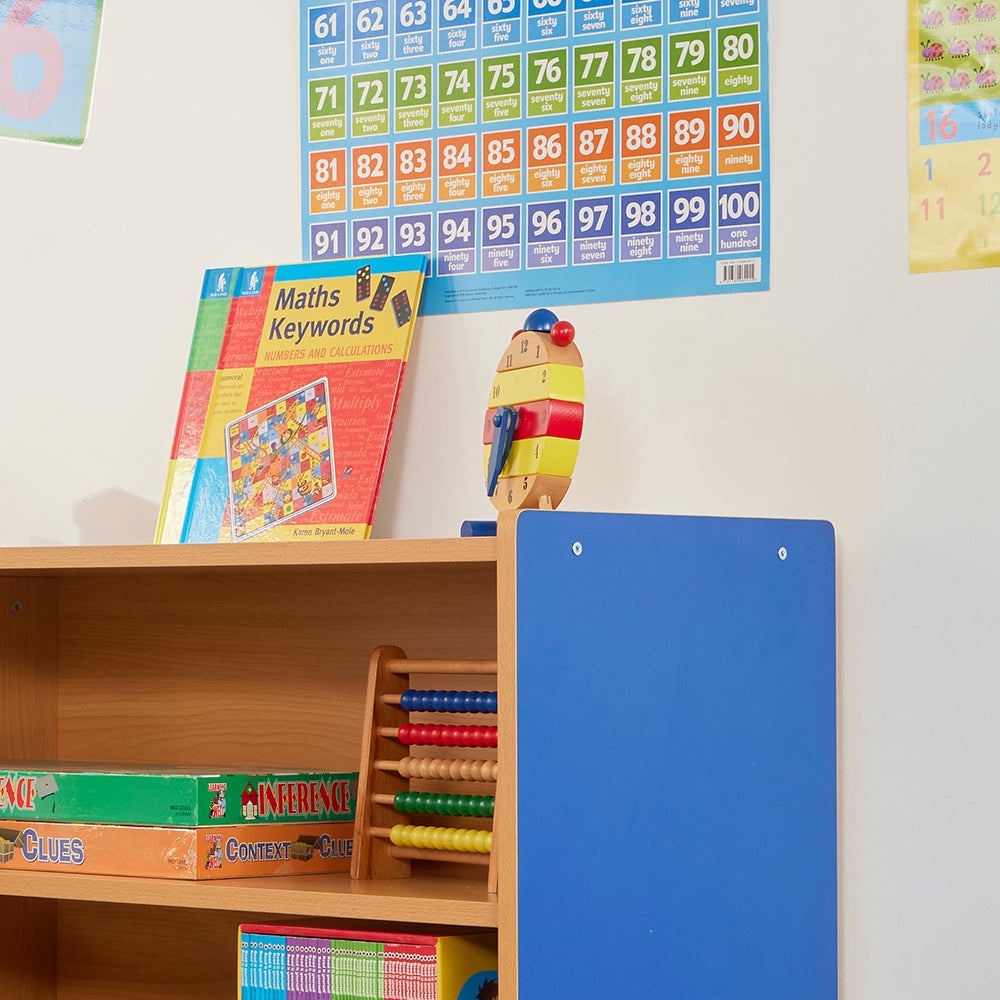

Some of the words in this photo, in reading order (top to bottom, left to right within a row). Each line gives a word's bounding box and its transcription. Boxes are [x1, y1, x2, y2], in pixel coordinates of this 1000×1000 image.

[631, 5, 652, 15] sixty
[679, 0, 700, 8] sixty
[400, 0, 426, 27] 63
[443, 0, 472, 21] 64
[583, 10, 605, 21] sixty
[680, 8, 699, 18] nine
[357, 7, 384, 33] 62
[537, 17, 557, 27] sixty
[582, 20, 606, 30] seven
[630, 13, 653, 25] eight
[315, 13, 337, 38] 61
[491, 23, 511, 33] sixty
[541, 27, 553, 36] six
[404, 35, 424, 45] sixty
[447, 29, 467, 39] sixty
[493, 32, 509, 42] five
[318, 46, 337, 56] sixty
[361, 41, 380, 51] sixty
[723, 33, 754, 61] 80
[675, 39, 705, 67] 79
[580, 51, 609, 79] 77
[627, 46, 656, 73] 78
[488, 63, 515, 90] 75
[534, 57, 561, 84] 76
[444, 69, 471, 95] 74
[625, 80, 658, 92] seventy
[672, 75, 707, 86] seventy
[724, 75, 753, 87] eighty
[357, 80, 384, 106] 72
[400, 74, 427, 101] 73
[577, 86, 610, 98] seventy
[680, 87, 699, 96] nine
[315, 85, 337, 111] 71
[531, 92, 564, 103] seventy
[581, 97, 606, 107] seven
[630, 91, 652, 103] eight
[441, 102, 473, 114] seventy
[486, 98, 517, 109] seventy
[541, 103, 553, 111] six
[355, 113, 386, 124] seventy
[398, 108, 429, 119] seventy
[493, 108, 509, 117] five
[312, 118, 343, 129] seventy
[722, 112, 754, 141] 90
[925, 108, 958, 141] 16
[626, 123, 656, 150] 88
[674, 118, 705, 145] 89
[533, 133, 561, 160] 86
[579, 128, 608, 155] 87
[443, 143, 472, 169] 84
[487, 139, 515, 165] 85
[400, 148, 426, 174] 83
[628, 157, 655, 170] eighty
[675, 153, 703, 165] eighty
[725, 153, 753, 165] ninety
[315, 158, 337, 183] 81
[357, 153, 384, 178] 82
[580, 164, 608, 175] eighty
[681, 164, 700, 174] nine
[924, 158, 933, 181] 1
[978, 153, 992, 176] 2
[489, 173, 515, 184] eighty
[534, 168, 561, 179] eighty
[581, 174, 606, 183] seven
[629, 168, 651, 180] eight
[401, 182, 426, 193] eighty
[444, 177, 470, 189] eighty
[493, 183, 508, 193] five
[541, 178, 553, 187] six
[316, 191, 341, 201] eighty
[358, 187, 382, 197] eighty
[674, 196, 705, 224] 99
[719, 191, 759, 219] 100
[921, 197, 945, 221] 11
[578, 205, 608, 232] 97
[626, 201, 656, 228] 98
[487, 213, 515, 240] 95
[532, 209, 562, 236] 96
[400, 222, 426, 248] 93
[442, 217, 471, 244] 94
[730, 229, 748, 238] one
[315, 230, 338, 255] 91
[357, 226, 384, 252] 92
[627, 236, 655, 247] ninety
[675, 231, 703, 243] ninety
[720, 237, 758, 249] hundred
[534, 244, 560, 255] ninety
[580, 240, 606, 251] ninety
[680, 242, 699, 252] nine
[444, 252, 469, 263] ninety
[488, 248, 514, 258] ninety
[581, 250, 606, 260] seven
[629, 246, 652, 258] eight
[493, 258, 508, 268] five
[541, 254, 552, 263] six
[448, 261, 465, 272] four
[274, 283, 341, 311] Maths
[268, 310, 375, 345] Keywords
[520, 339, 529, 354] 12
[264, 349, 305, 362] NUMBERS
[308, 346, 328, 359] AND
[329, 344, 394, 358] CALCULATIONS
[314, 526, 356, 538] Bryant-Mole
[258, 779, 350, 816] INFERENCE
[22, 828, 85, 865] CLUES
[226, 836, 290, 863] CONTEXT
[319, 833, 353, 859] CLUE
